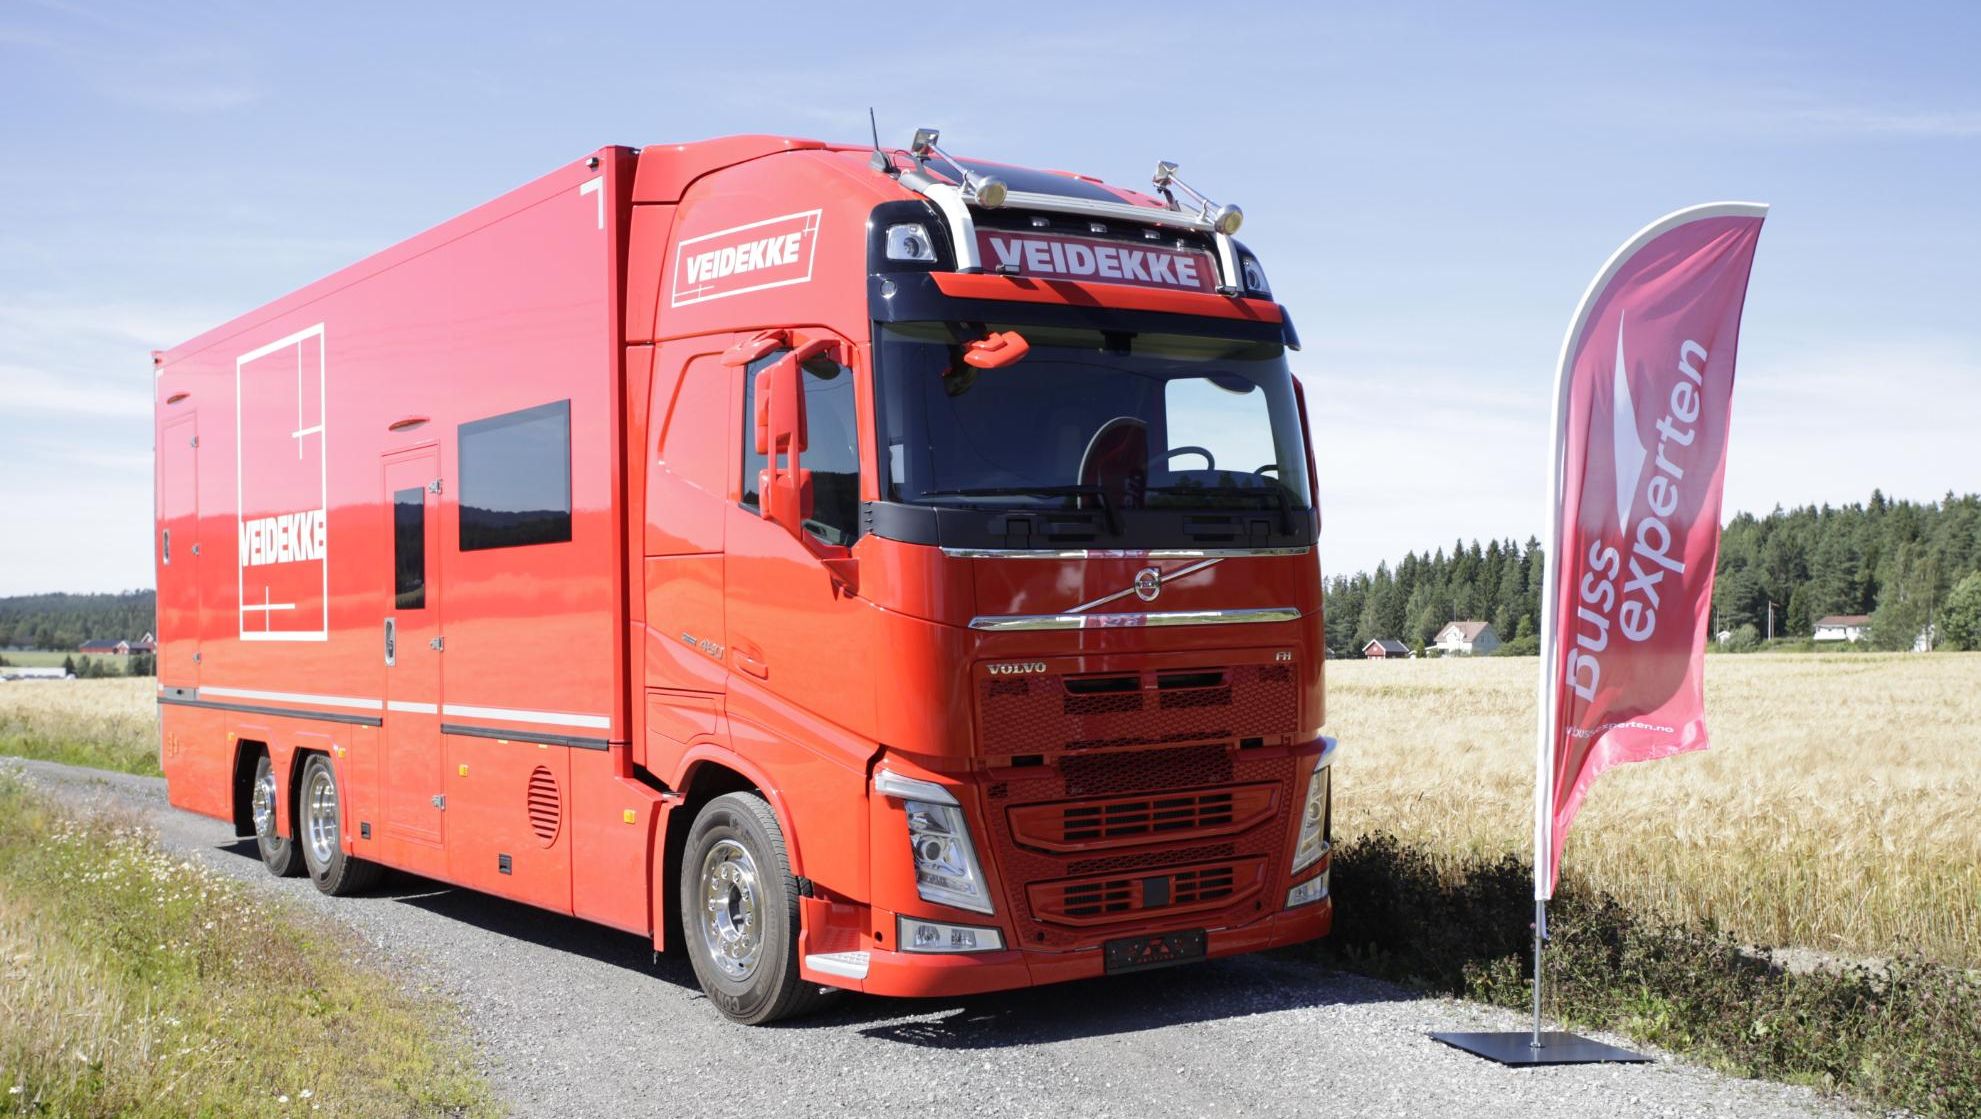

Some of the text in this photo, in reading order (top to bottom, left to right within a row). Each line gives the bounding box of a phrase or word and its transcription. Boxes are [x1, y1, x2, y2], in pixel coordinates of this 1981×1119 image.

[687, 231, 802, 285] VEIDEKKE
[990, 237, 1200, 287] VEIDEKKE
[1619, 338, 1708, 642] experten
[239, 508, 327, 567] VEIDEKKE
[987, 662, 1046, 674] VOLVO
